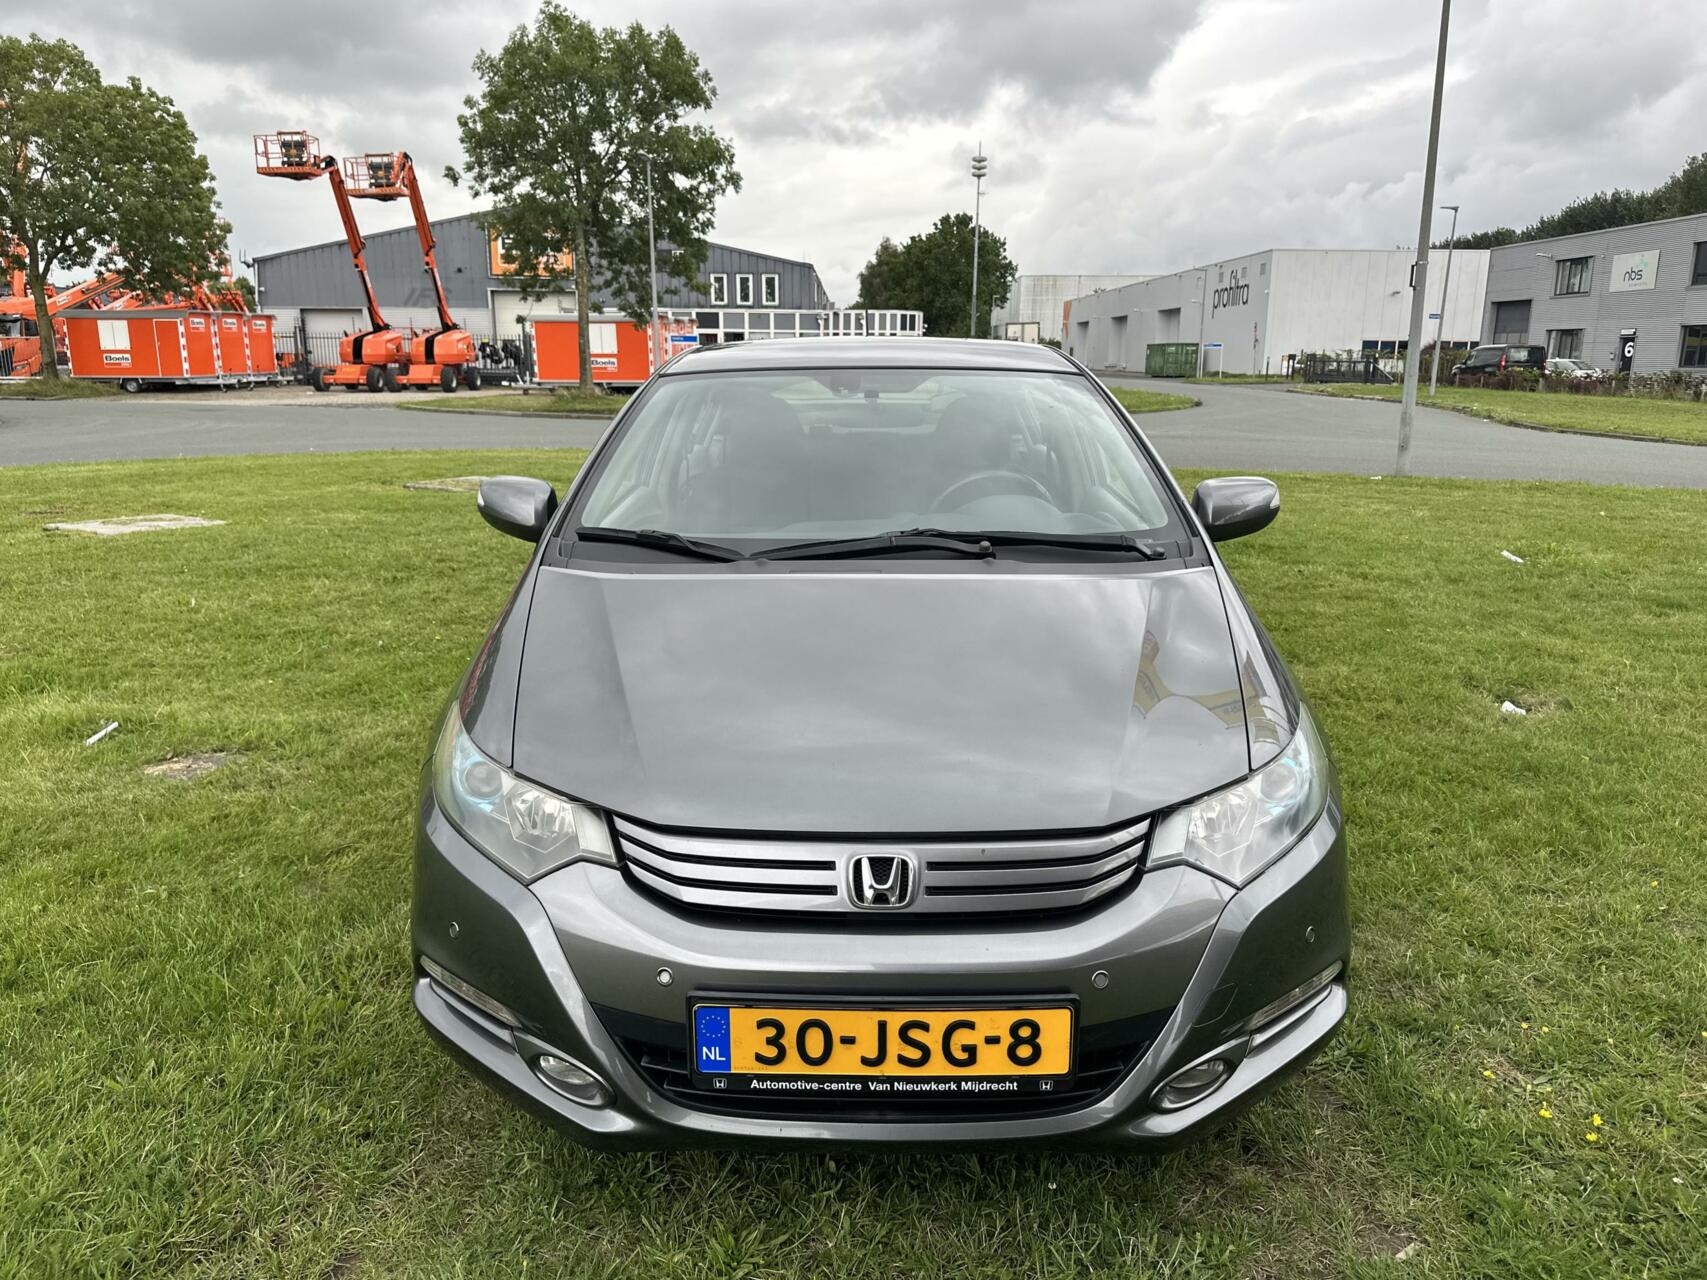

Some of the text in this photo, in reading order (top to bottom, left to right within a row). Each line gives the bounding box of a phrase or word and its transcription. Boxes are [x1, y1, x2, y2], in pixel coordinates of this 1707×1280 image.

[1623, 266, 1643, 282] nbs
[1211, 269, 1250, 320] profiltra
[1624, 341, 1634, 357] 6
[754, 1018, 1042, 1068] 30-JSG-8
[702, 1046, 726, 1061] NL
[750, 1079, 1018, 1093] Automotive-centre Van Nieuwkerk Mijdrecht
